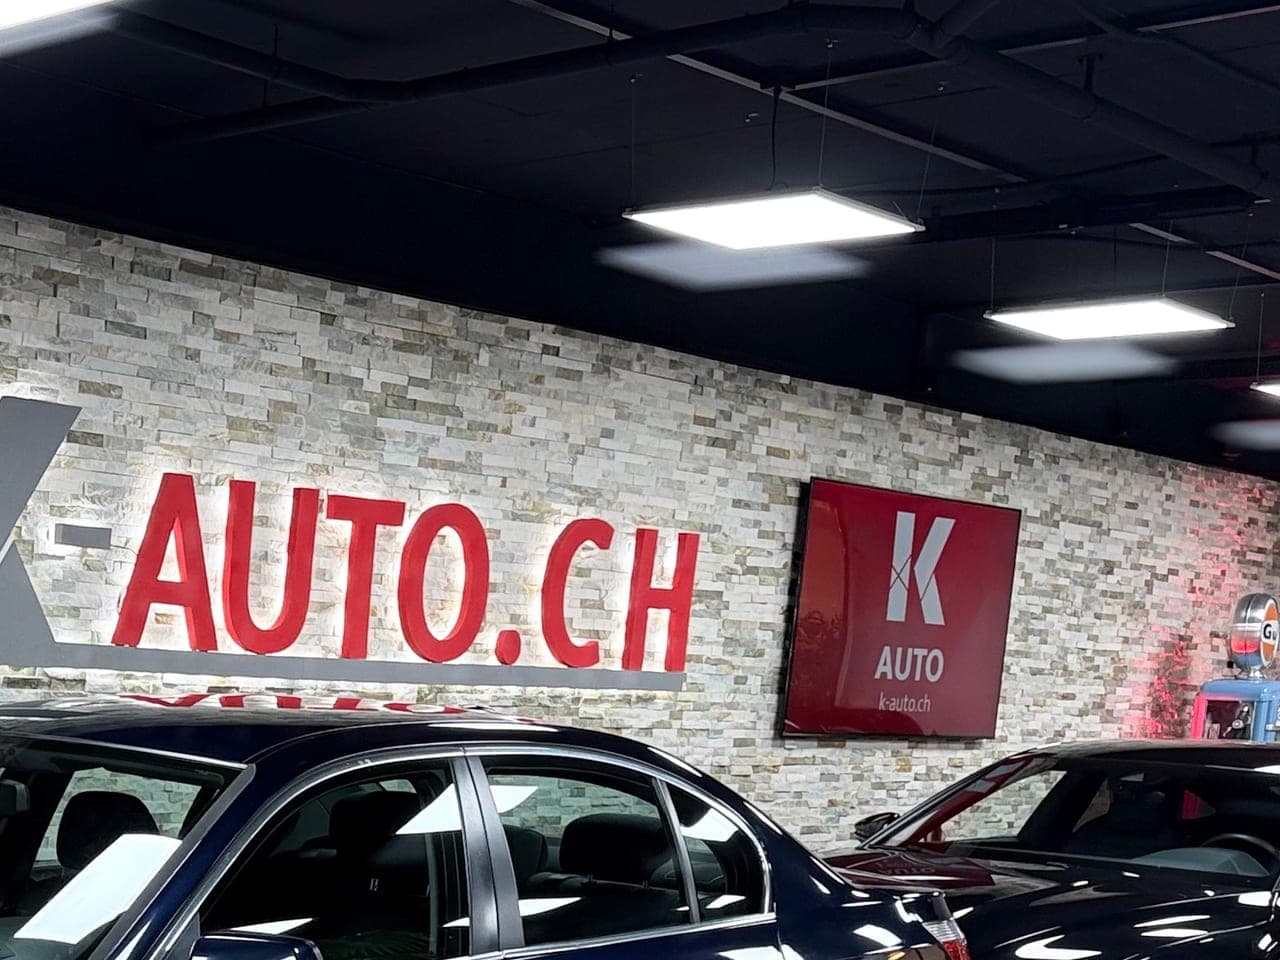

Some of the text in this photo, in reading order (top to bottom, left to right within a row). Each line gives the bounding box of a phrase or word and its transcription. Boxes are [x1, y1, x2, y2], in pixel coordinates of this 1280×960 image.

[886, 510, 956, 626] K
[874, 646, 945, 682] AUTO
[878, 691, 931, 713] k-auto.ch
